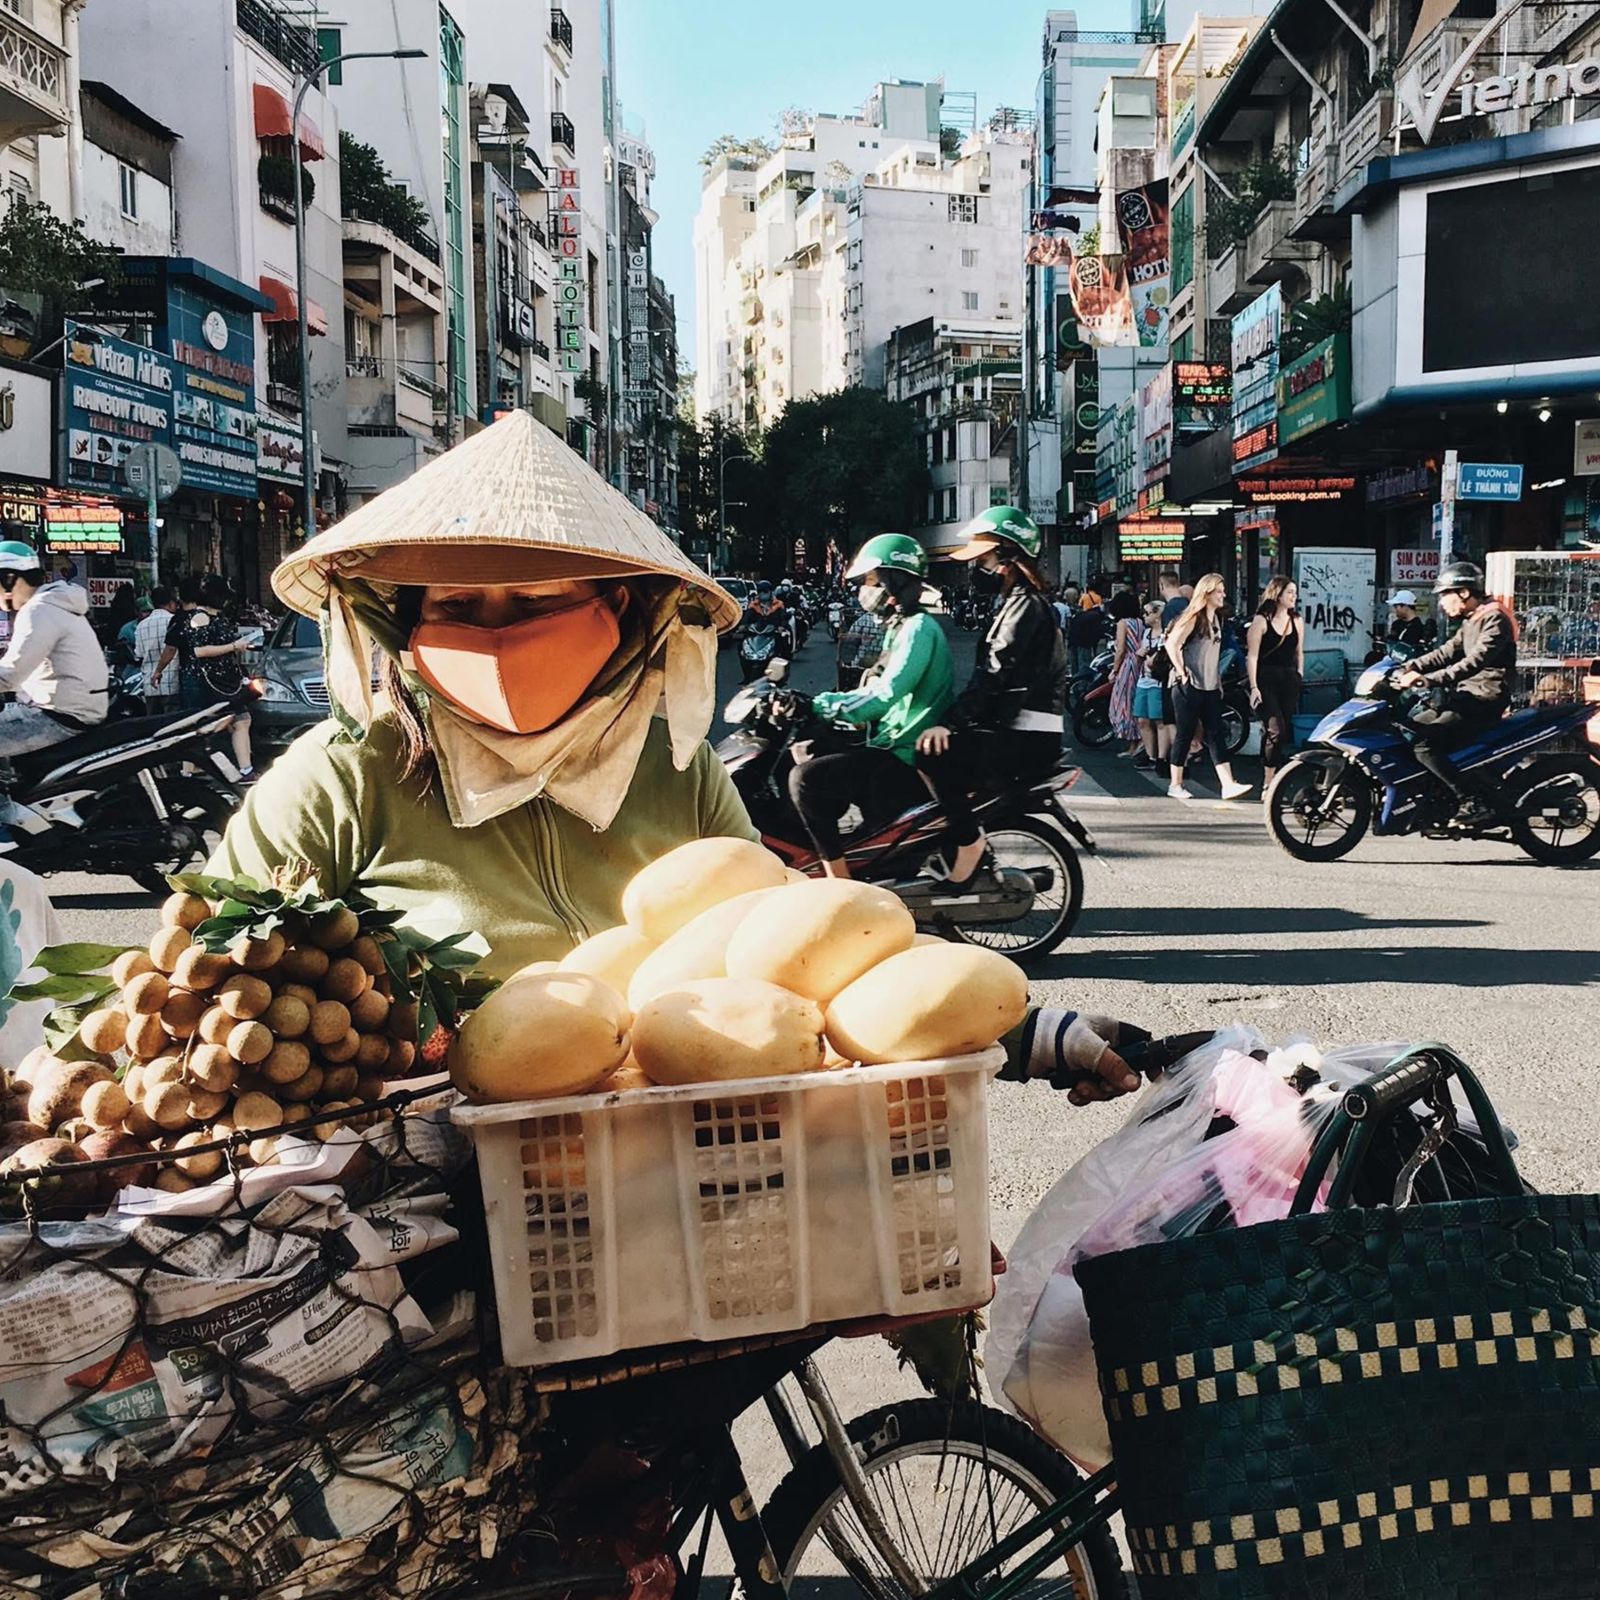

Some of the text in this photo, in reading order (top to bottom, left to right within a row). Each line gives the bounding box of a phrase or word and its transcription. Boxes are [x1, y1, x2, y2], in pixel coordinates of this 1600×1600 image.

[559, 169, 577, 256] HALO
[1133, 261, 1161, 282] HOT
[563, 263, 581, 370] HOTEL
[93, 343, 135, 380] Vietnam
[136, 351, 172, 391] Airlines
[73, 384, 132, 420] RAINBOW
[130, 401, 168, 430] TOURS
[1252, 491, 1341, 502] tourbooking.com.vn
[1397, 552, 1439, 566] SIM CARD
[1398, 570, 1438, 580] 3G-4G
[89, 580, 106, 594] SIM
